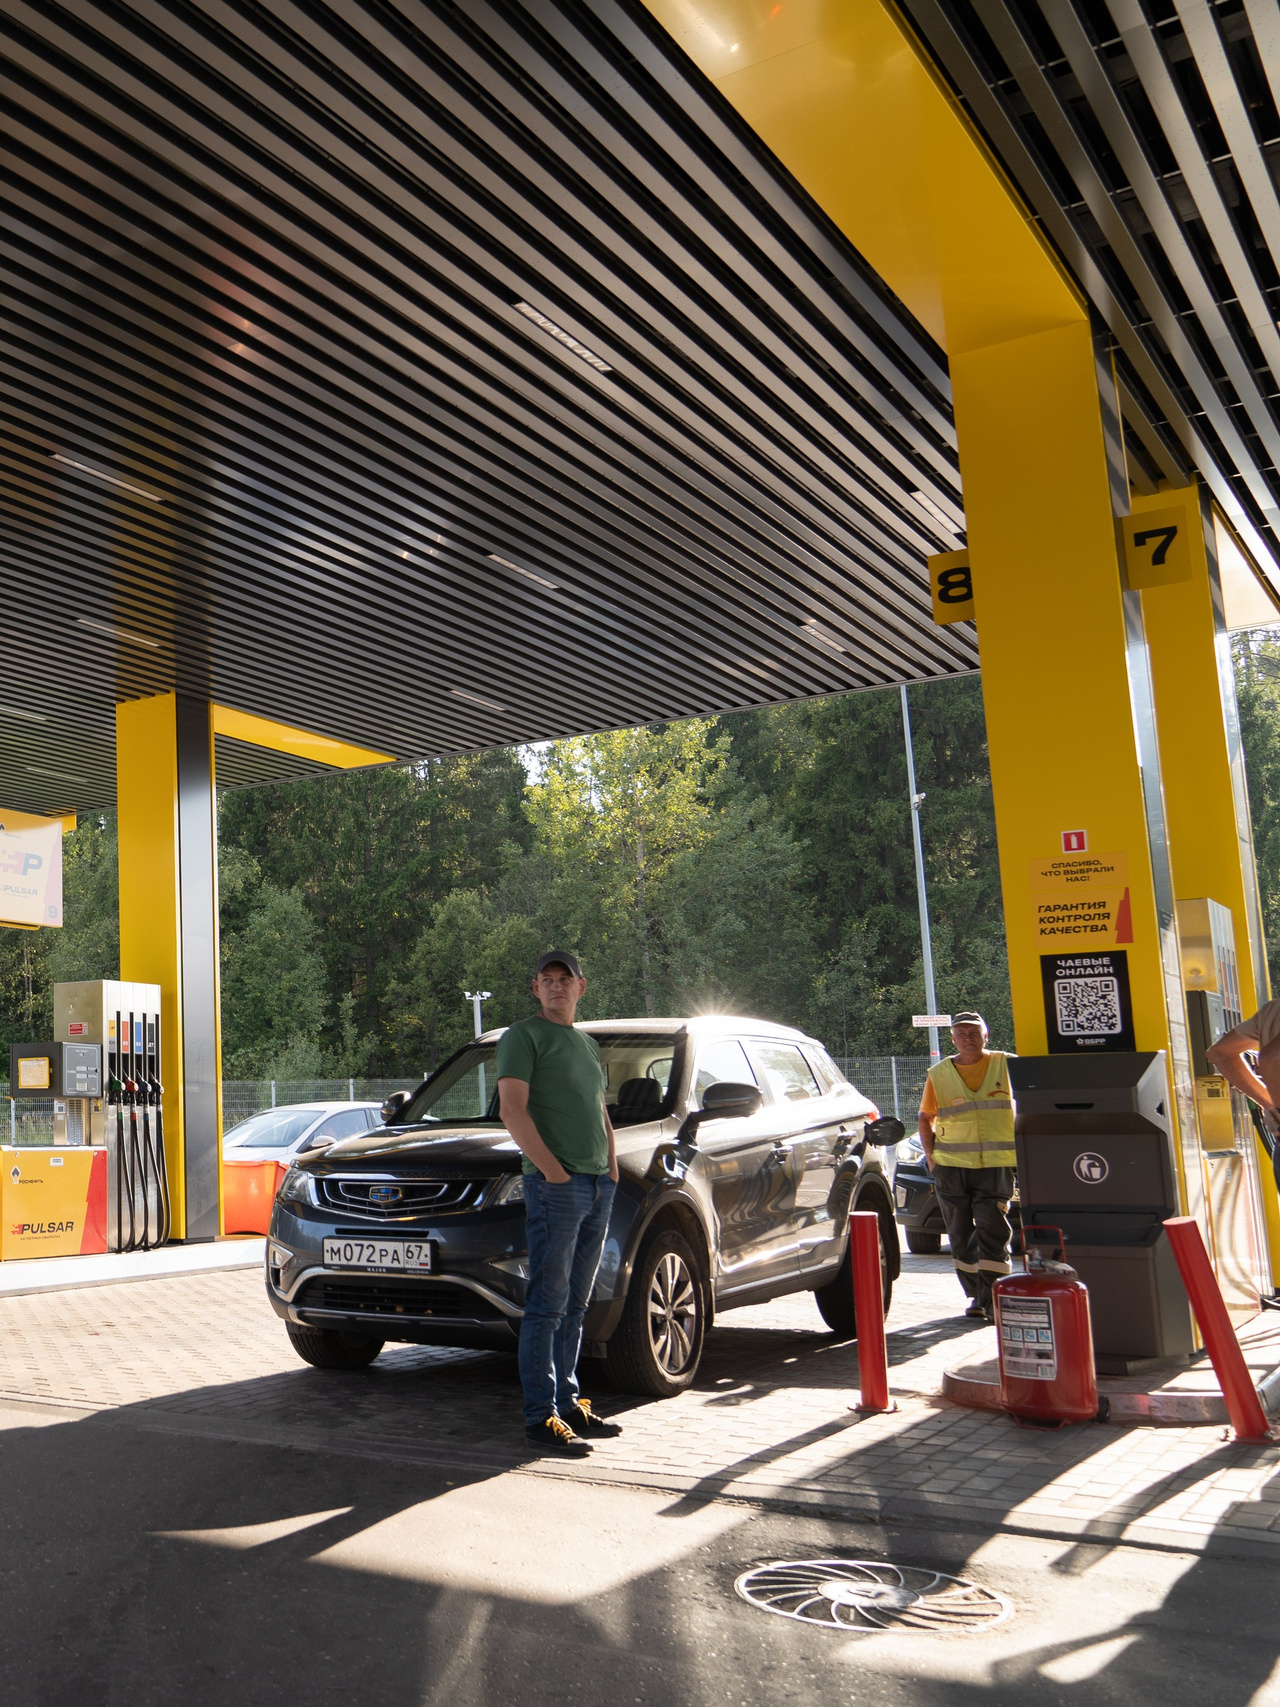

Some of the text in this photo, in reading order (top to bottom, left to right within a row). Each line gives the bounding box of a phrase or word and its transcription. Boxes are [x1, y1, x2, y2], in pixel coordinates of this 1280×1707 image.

[1133, 525, 1177, 566] 7
[937, 567, 973, 603] 8
[1051, 859, 1102, 869] СПАСИБО,
[1063, 866, 1114, 875] ВЫБРАЛИ
[5, 885, 38, 896] PULSAR
[48, 905, 58, 919] 9
[1038, 901, 1107, 913] ГАРАНТИЯ
[1038, 912, 1111, 924] КОНТРОЛЯ
[1039, 924, 1109, 936] КАЧЕСТВА
[1056, 957, 1111, 967] ЧАЕВЫЕ
[1056, 966, 1114, 976] ОНЛАЙН
[21, 1221, 74, 1234] PULSAR
[330, 1243, 423, 1265] М072РА 67
